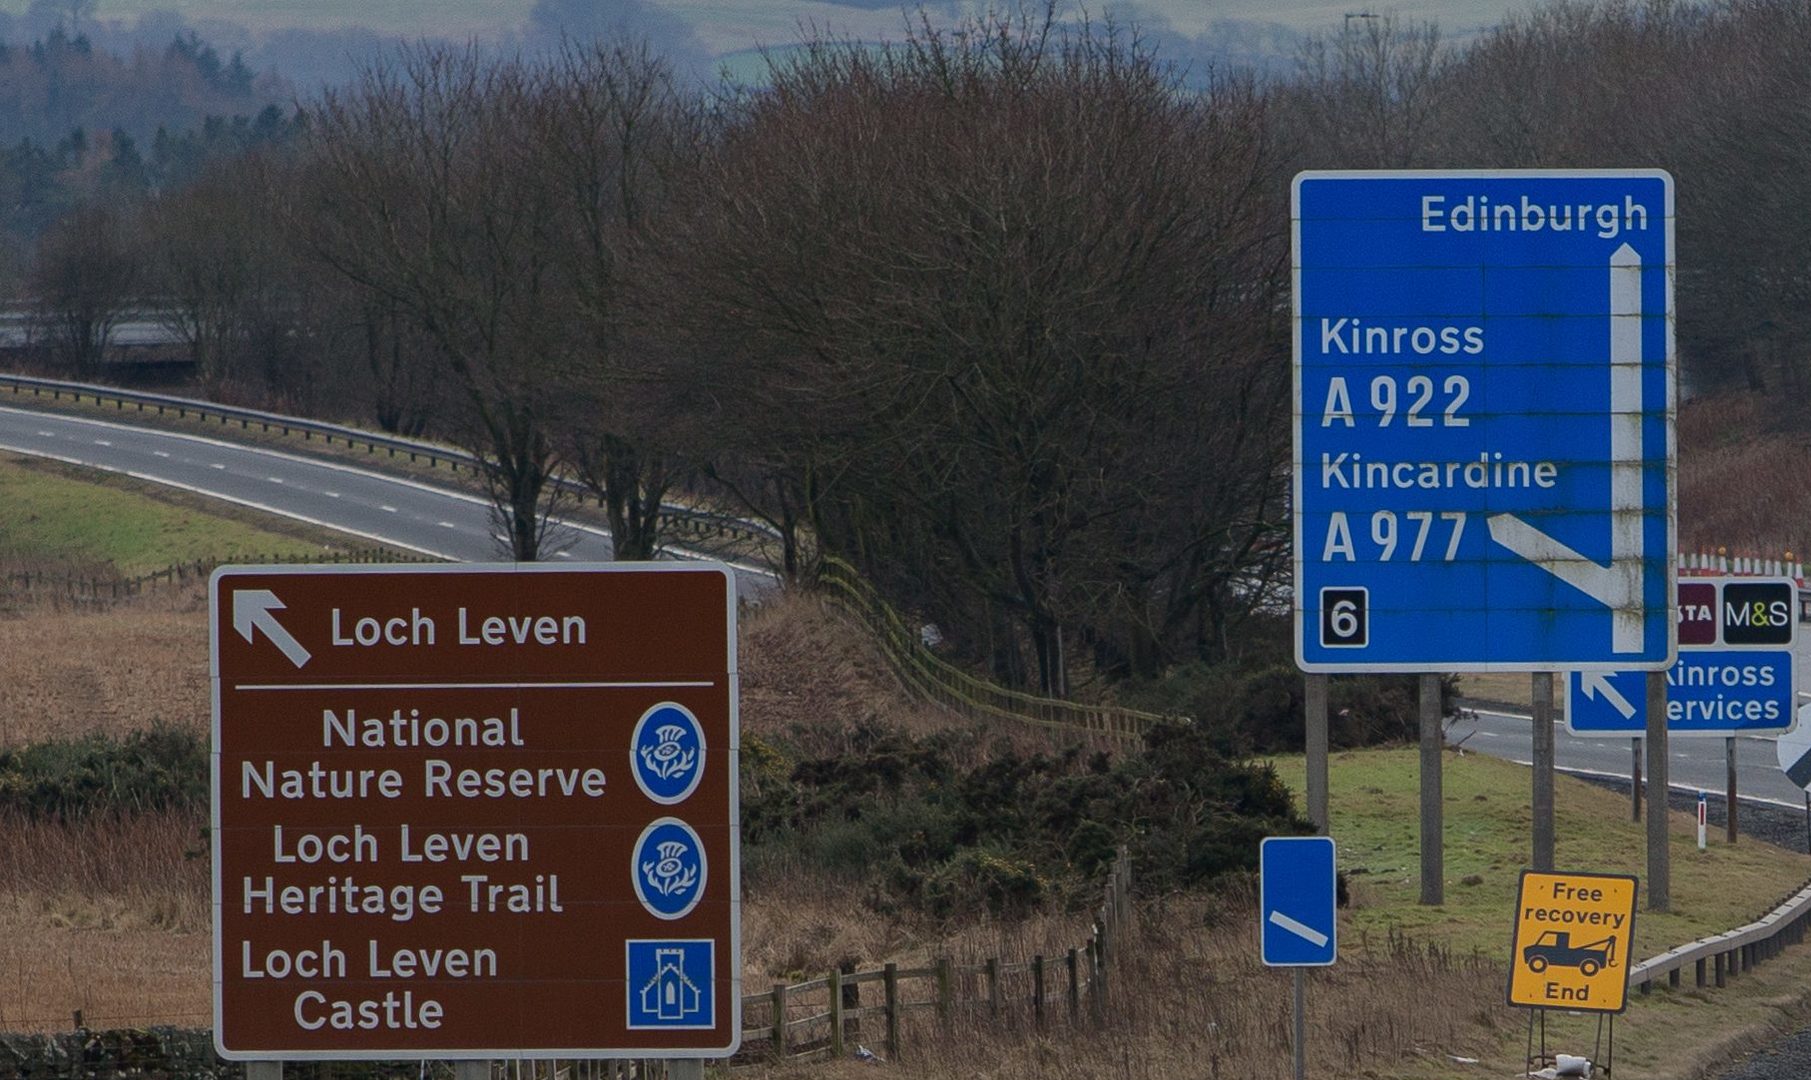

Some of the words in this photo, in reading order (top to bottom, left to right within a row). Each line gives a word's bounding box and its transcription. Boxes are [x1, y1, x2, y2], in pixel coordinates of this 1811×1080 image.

[1422, 194, 1647, 239] Edinburgh
[1321, 318, 1484, 355] Kinross
[1322, 451, 1558, 489] Kincardine
[332, 607, 435, 647] Loch
[458, 607, 586, 646] Leven
[1331, 599, 1358, 638] 6
[1726, 601, 1788, 627] M&S
[1666, 693, 1780, 721] ervices
[323, 707, 525, 747] National
[242, 760, 403, 799] Nature
[425, 759, 607, 798] Reserve
[274, 824, 378, 863] Loch
[400, 823, 529, 862] Leven
[243, 876, 444, 922] Heritage
[460, 874, 563, 913] Trail
[1552, 881, 1604, 902] Free
[1524, 906, 1626, 930] recovery
[242, 939, 346, 979] Loch
[369, 939, 497, 978] Leven
[293, 990, 444, 1030] Castle
[1545, 981, 1590, 1001] End
